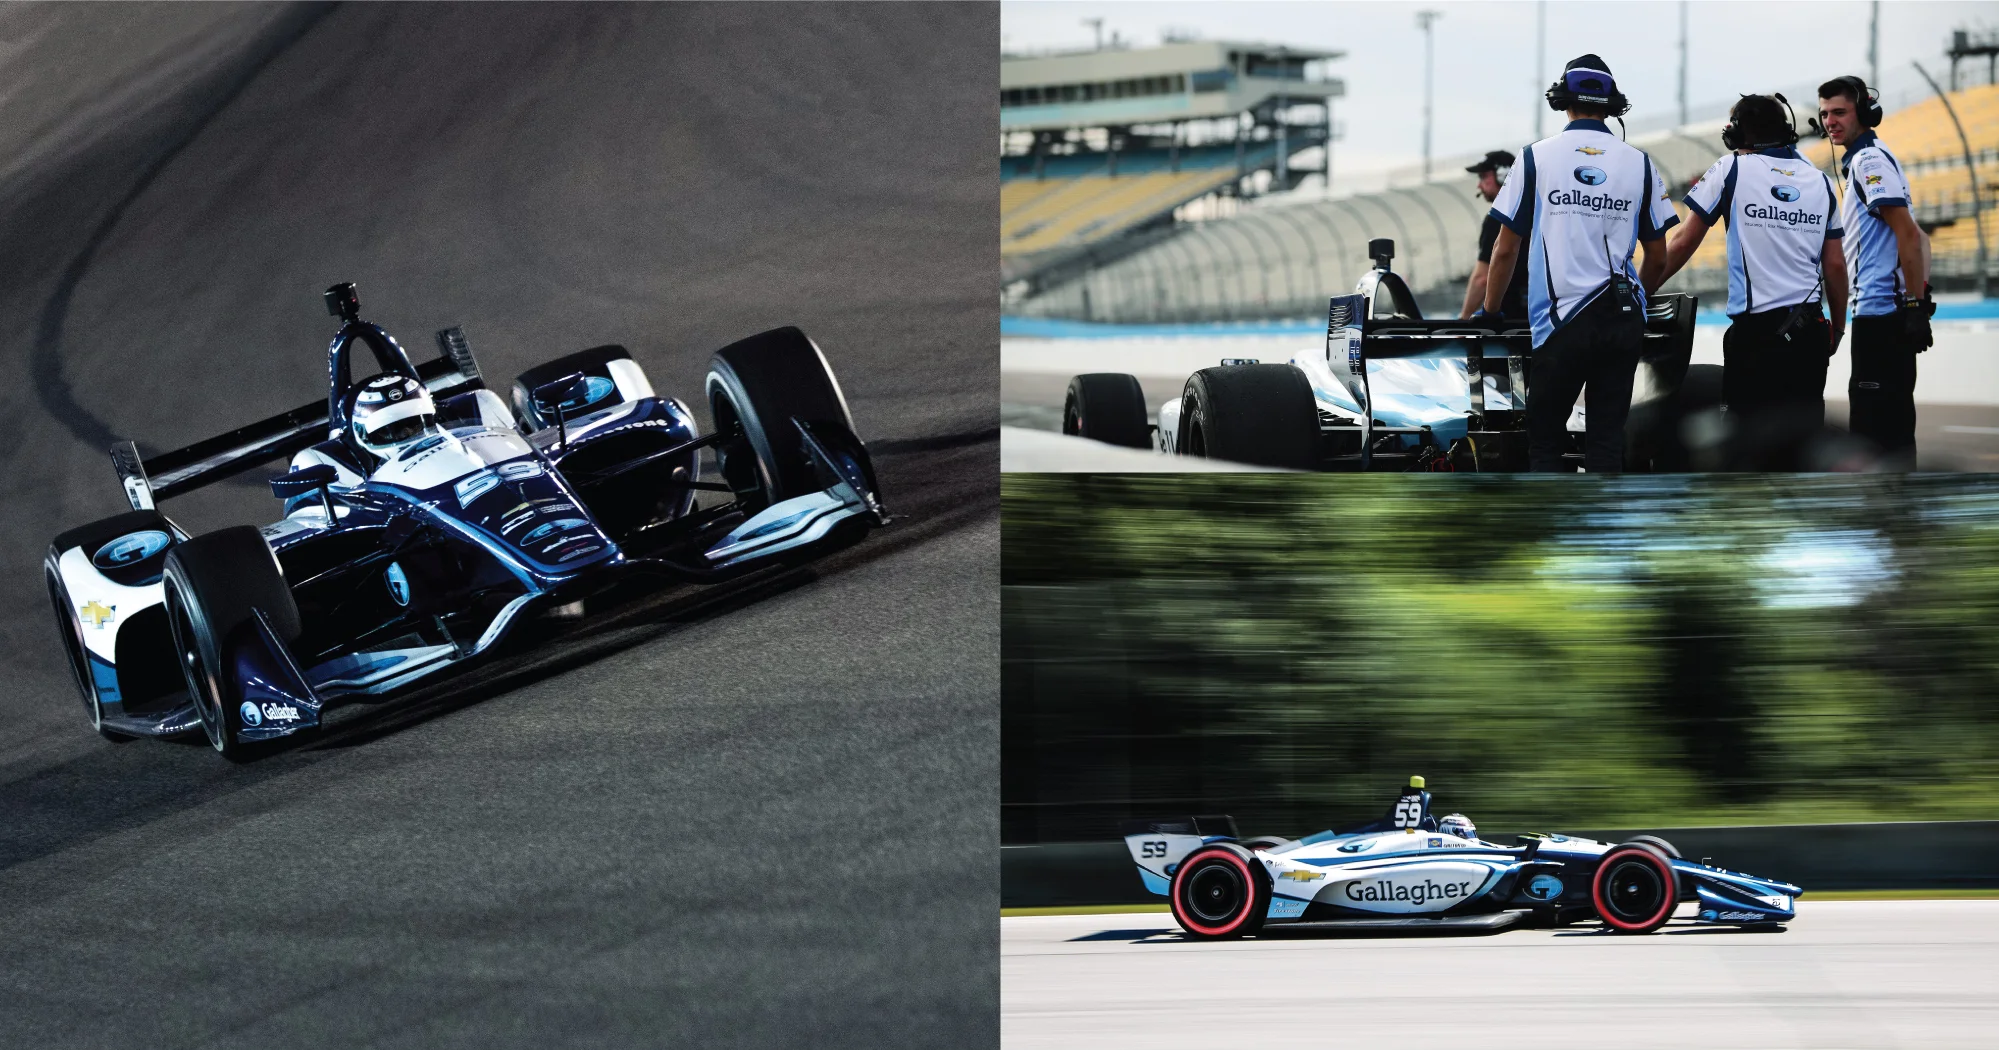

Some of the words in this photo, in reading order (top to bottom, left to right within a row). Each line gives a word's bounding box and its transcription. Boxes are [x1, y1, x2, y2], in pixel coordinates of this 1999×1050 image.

[1548, 190, 1632, 212] Gallagher
[1744, 203, 1823, 226] Gallagher
[453, 461, 545, 510] 59
[261, 702, 301, 723] Gallagher
[1394, 803, 1421, 828] 59
[1142, 841, 1167, 858] 59
[1345, 880, 1470, 905] Gallagher
[1718, 911, 1766, 921] Gallagher
